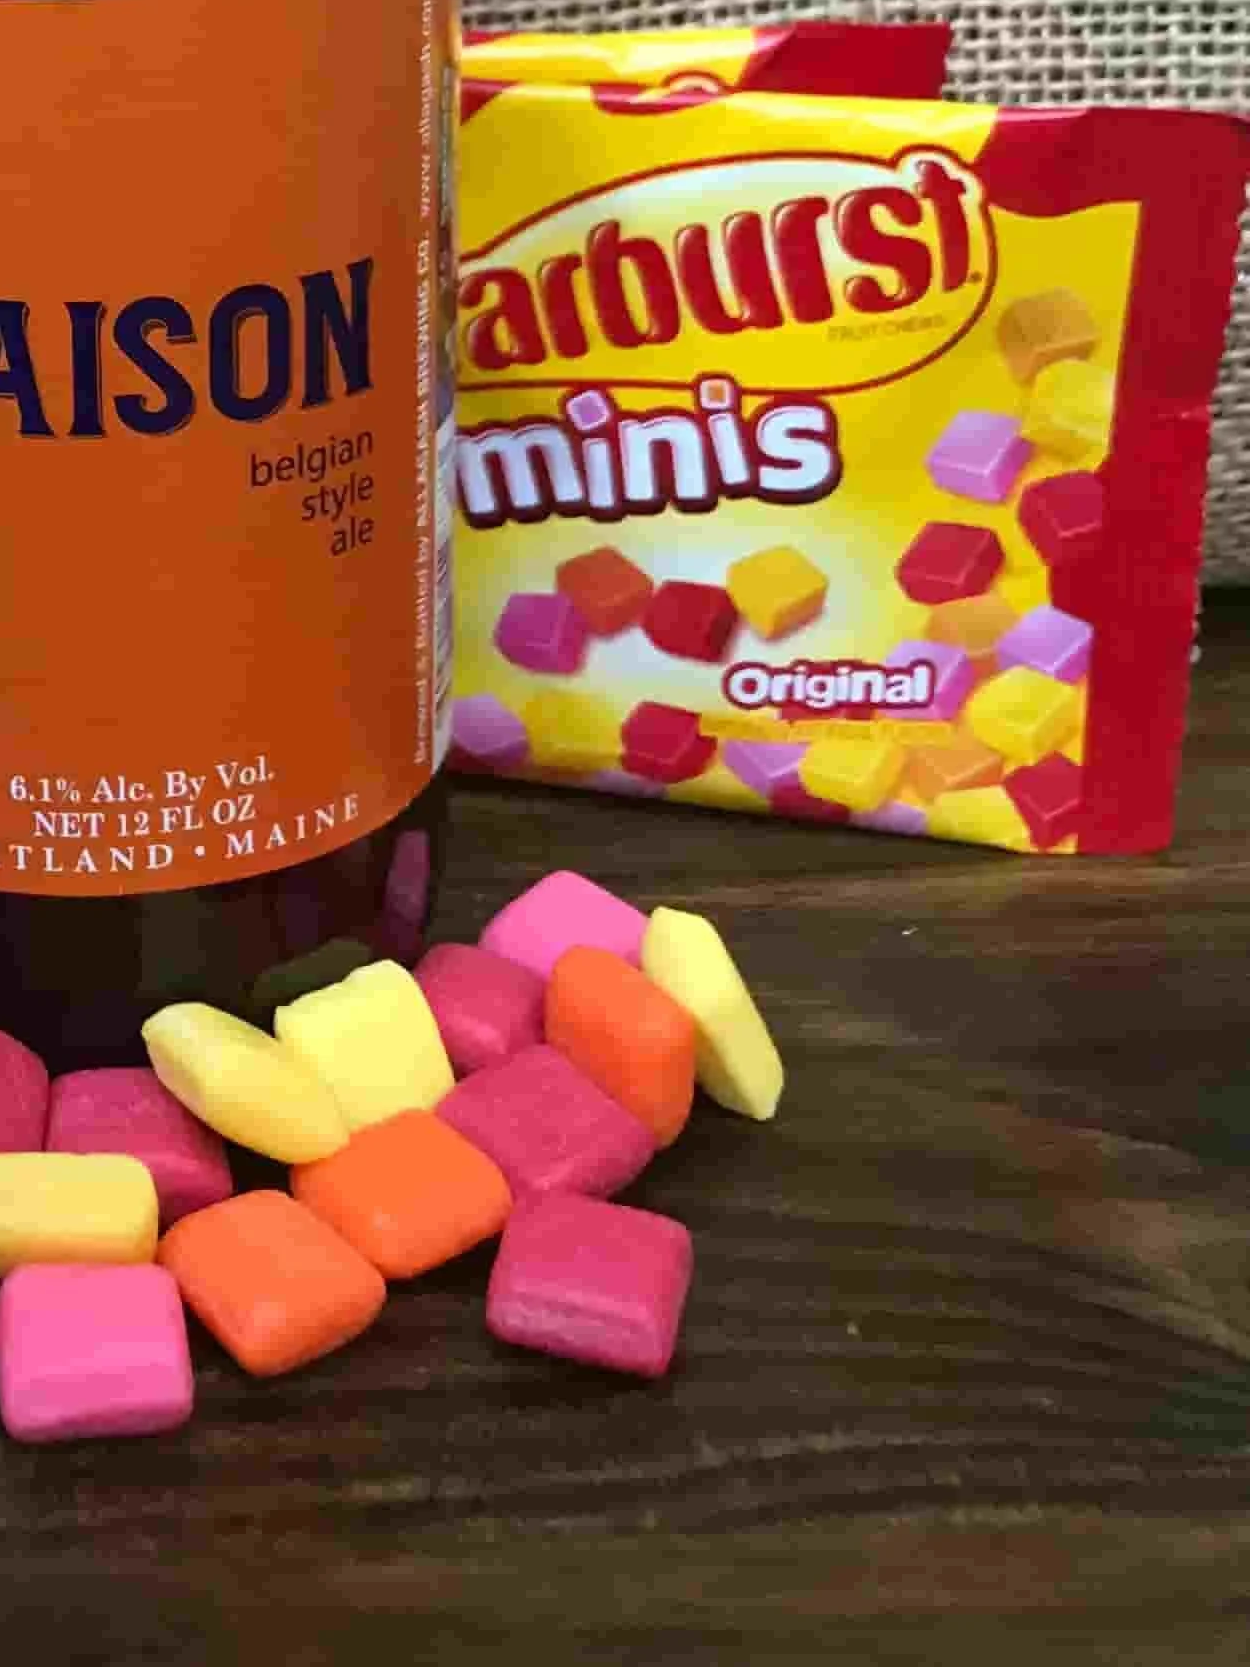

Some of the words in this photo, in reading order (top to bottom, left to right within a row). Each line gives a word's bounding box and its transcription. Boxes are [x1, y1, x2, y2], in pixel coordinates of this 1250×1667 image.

[458, 158, 969, 371] arburst
[251, 431, 373, 488] belgian
[454, 381, 834, 514] minis
[301, 472, 374, 523] style
[331, 516, 374, 556] ale
[729, 665, 930, 709] Original
[10, 775, 81, 804] 6.1%
[91, 775, 154, 803] Alc.
[165, 770, 206, 801] By
[215, 755, 275, 789] Vol.
[31, 810, 105, 838] NET
[117, 812, 150, 837] 12
[160, 805, 204, 833] FL
[212, 794, 257, 825] OZ
[224, 793, 359, 859] MAINE
